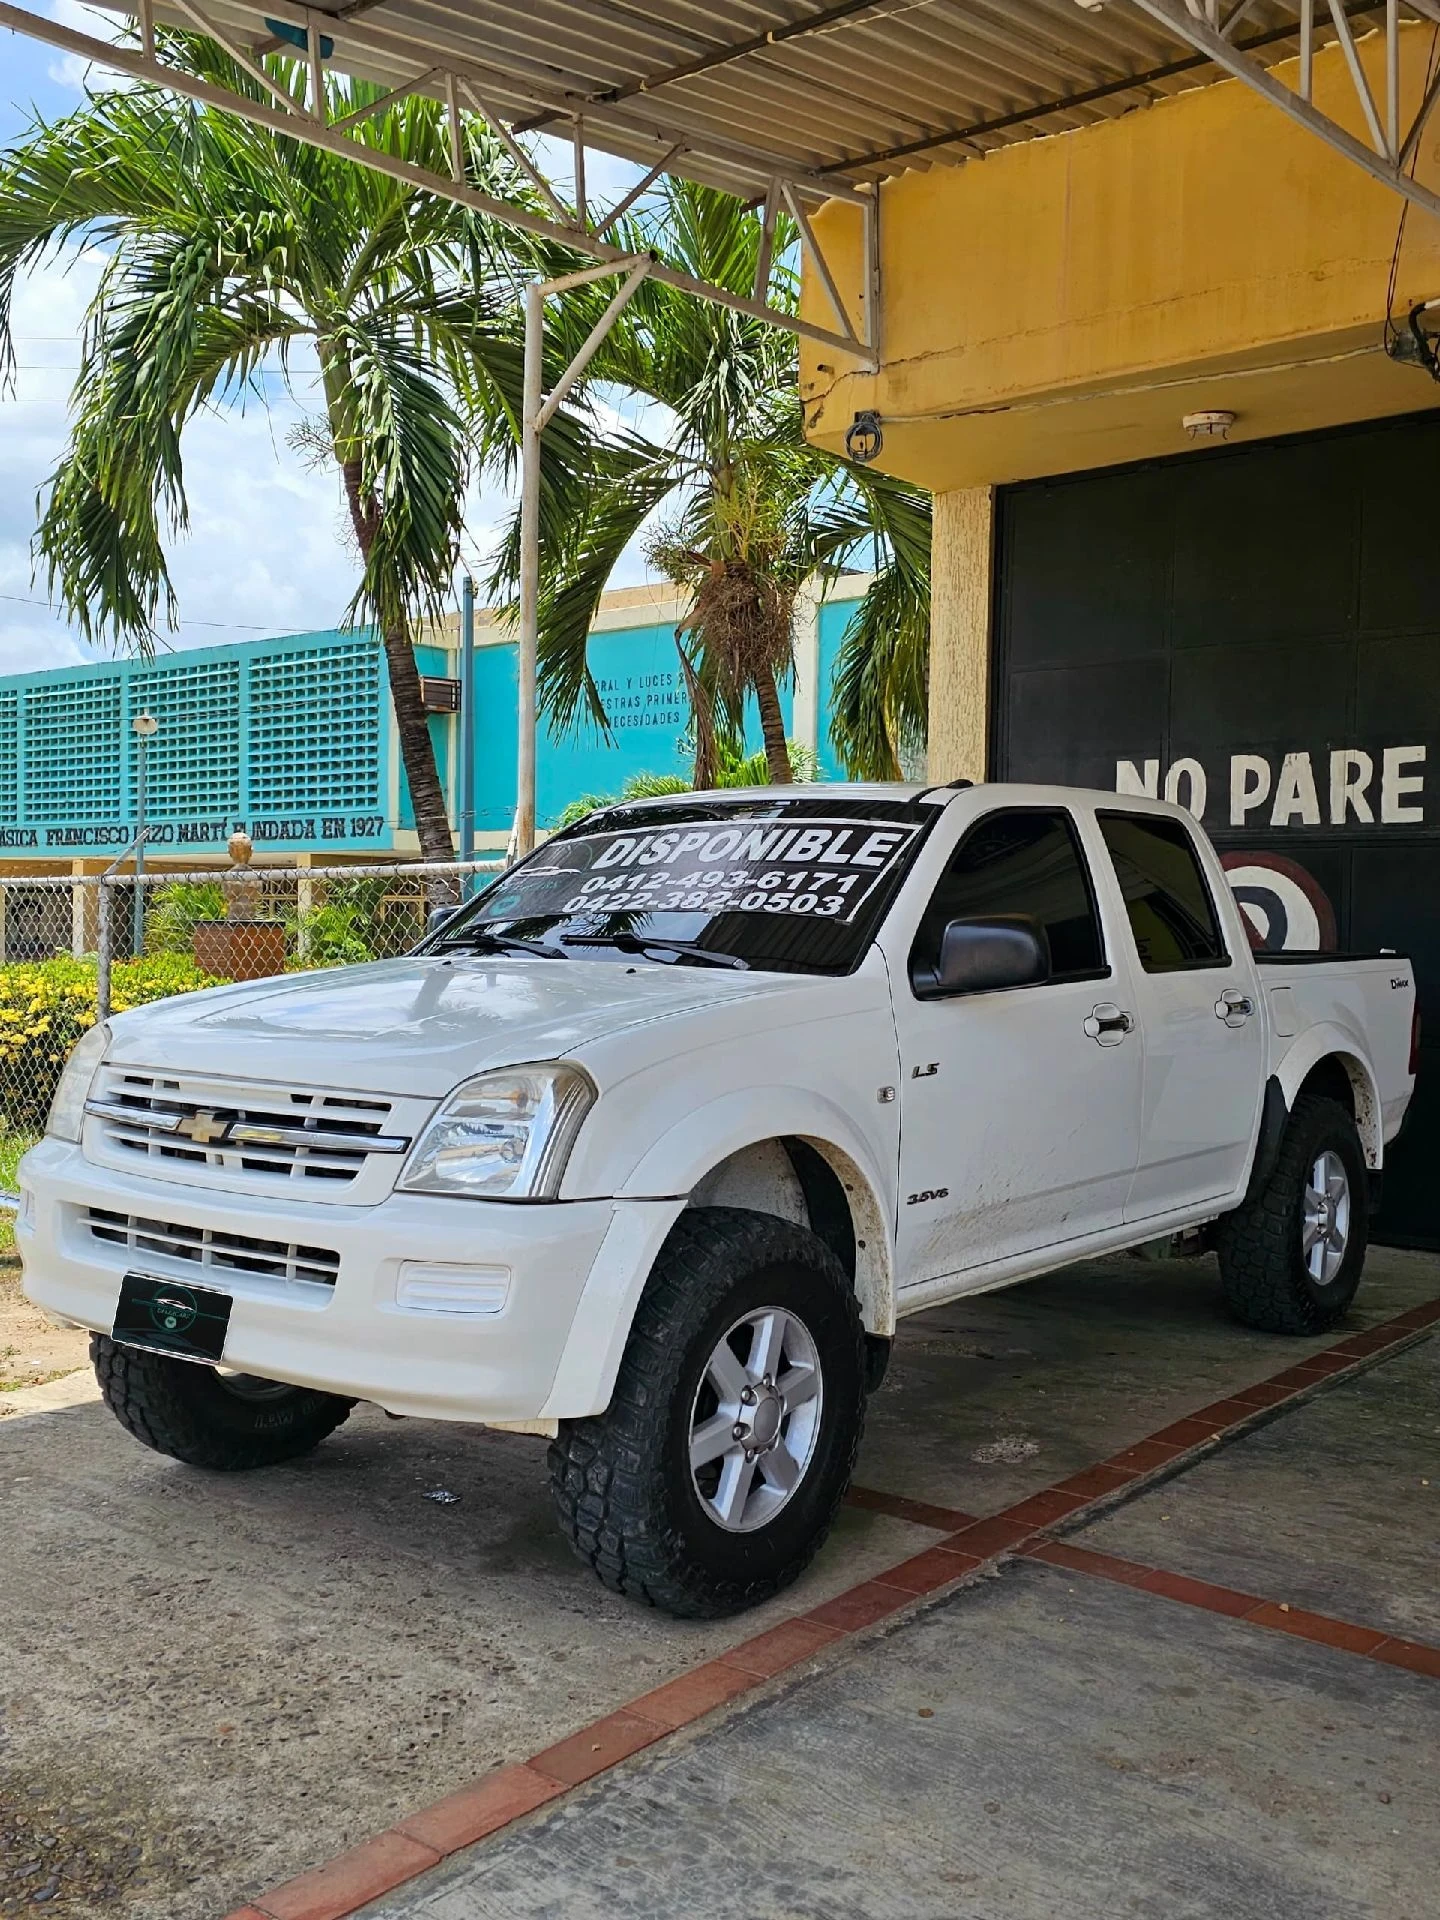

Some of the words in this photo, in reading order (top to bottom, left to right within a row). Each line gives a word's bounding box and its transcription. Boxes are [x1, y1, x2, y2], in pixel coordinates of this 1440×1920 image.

[595, 679, 619, 693] ORAL
[626, 677, 633, 690] Y
[639, 673, 673, 689] LUCES
[646, 691, 688, 708] PRIMER
[1116, 757, 1207, 822] NO
[1230, 746, 1426, 827] PARE
[46, 826, 129, 846] FRANCISCO
[176, 816, 229, 843] MARTÍ
[321, 817, 347, 840] EN
[350, 815, 384, 838] 1927
[590, 829, 903, 870] DISPONIBLE
[580, 870, 860, 894] 0412-493-6171
[562, 890, 845, 916] 0422-382-0503
[911, 1062, 941, 1080] LS
